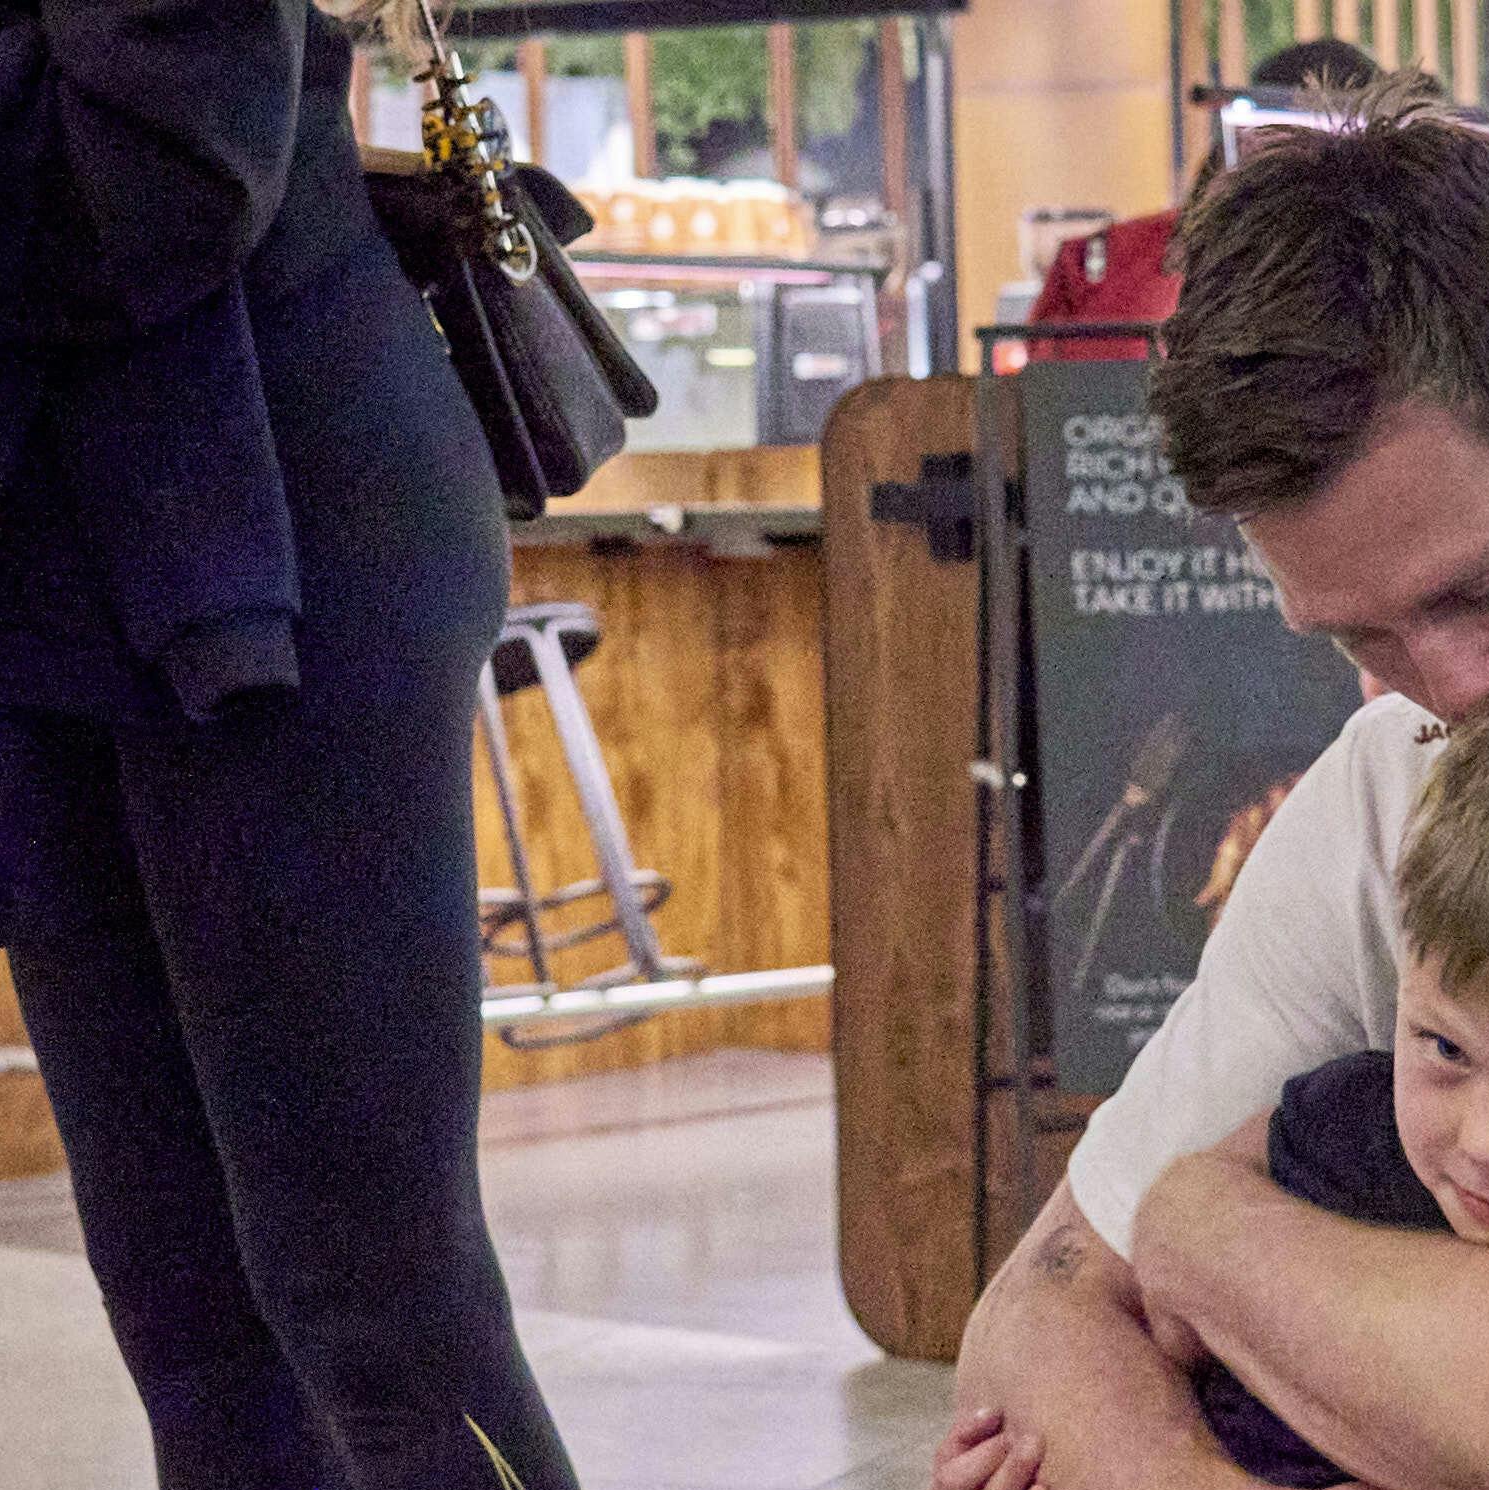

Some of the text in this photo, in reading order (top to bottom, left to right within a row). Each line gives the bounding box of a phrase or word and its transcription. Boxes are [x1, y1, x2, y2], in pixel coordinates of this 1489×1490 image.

[1063, 415, 1167, 448] ORGA
[1066, 482, 1148, 513] AND
[1070, 548, 1186, 582] ENJOY
[1073, 583, 1151, 614] TAKE
